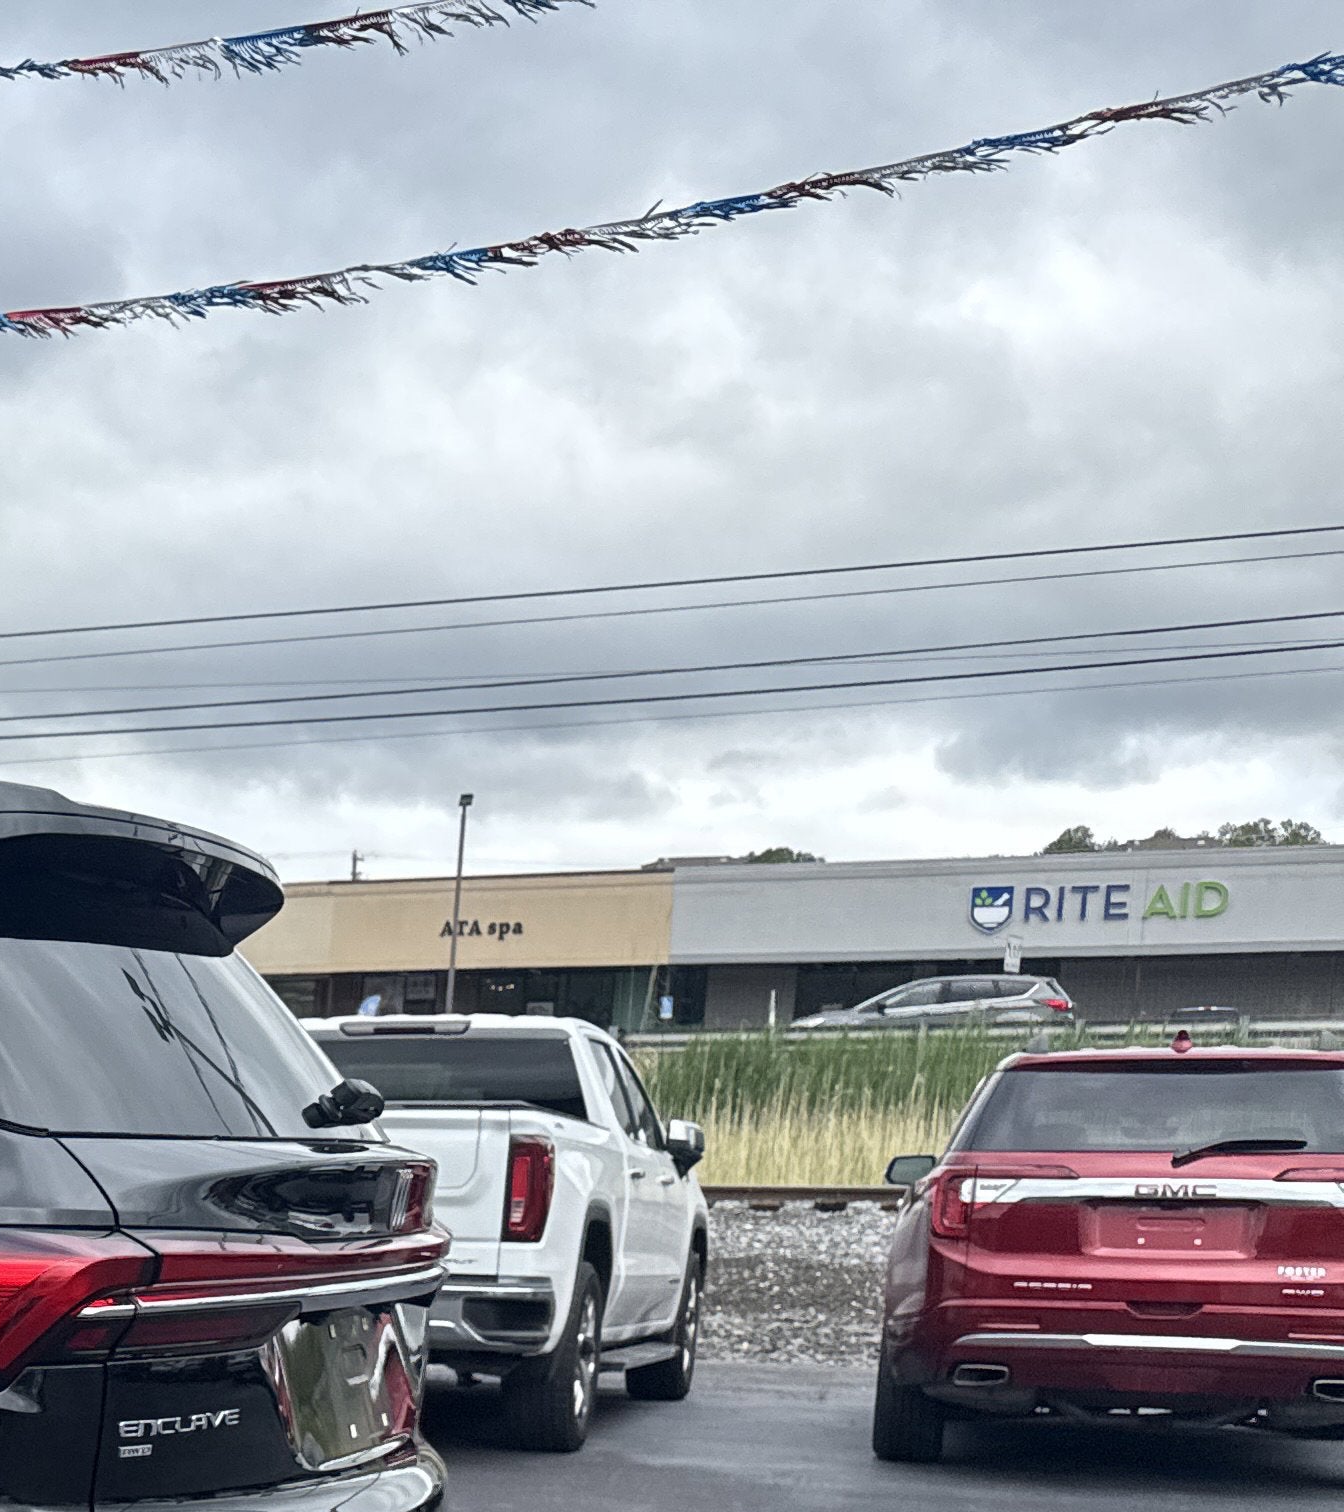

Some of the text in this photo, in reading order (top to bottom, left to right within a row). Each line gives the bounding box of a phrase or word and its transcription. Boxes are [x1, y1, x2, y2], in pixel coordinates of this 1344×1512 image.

[1023, 880, 1229, 923] RITE AID
[488, 922, 523, 941] spa
[1134, 1184, 1217, 1198] GMC
[118, 1408, 241, 1438] ENCLAVE
